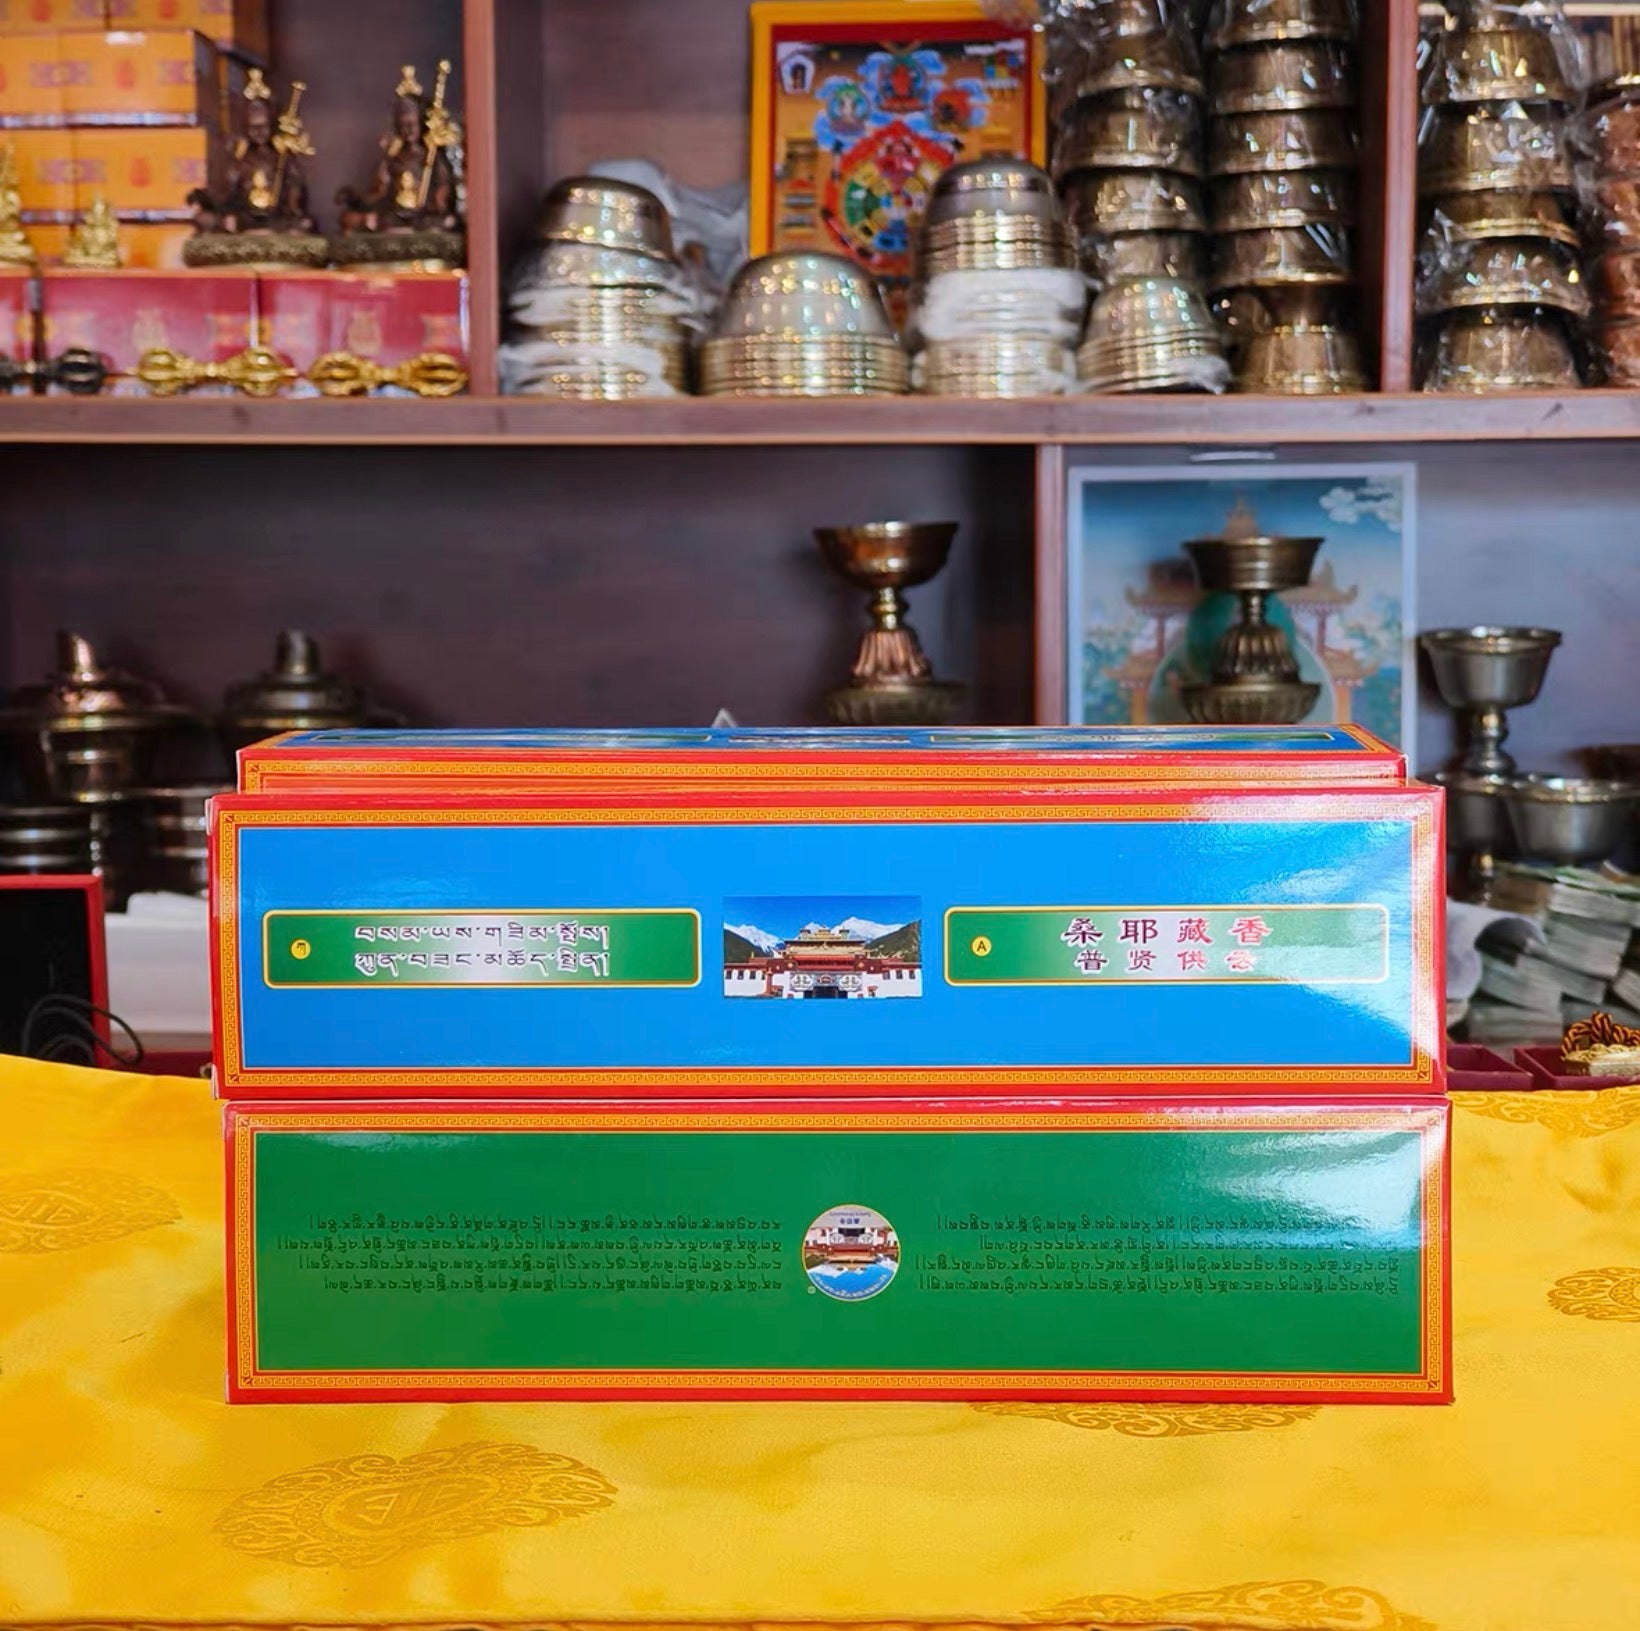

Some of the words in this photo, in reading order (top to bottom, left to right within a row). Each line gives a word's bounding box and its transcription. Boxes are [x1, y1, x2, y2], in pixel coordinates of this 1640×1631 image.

[1061, 916, 1272, 948] 桑耶藏香
[976, 940, 988, 953] A
